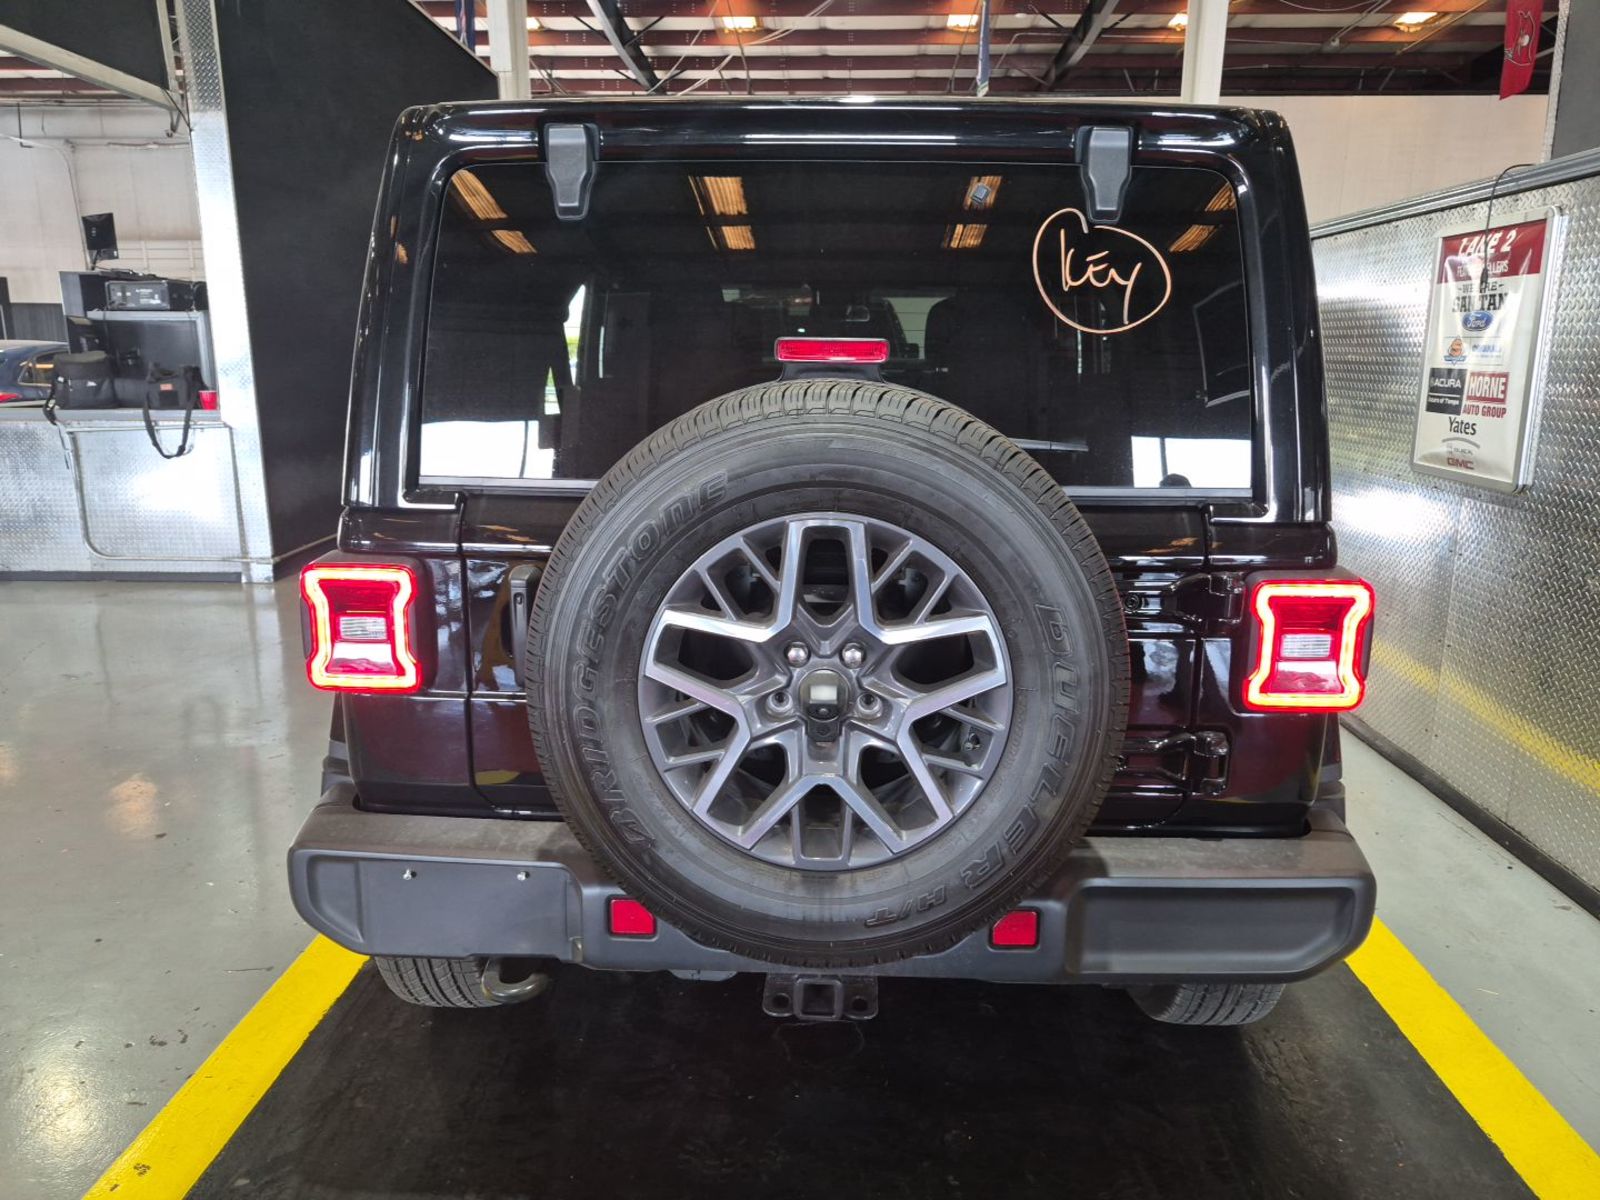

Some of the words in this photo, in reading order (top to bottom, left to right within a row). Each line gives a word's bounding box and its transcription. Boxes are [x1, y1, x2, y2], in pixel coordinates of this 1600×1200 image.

[1500, 228, 1518, 252] 2
[1466, 313, 1488, 327] Ford
[1434, 378, 1461, 388] ACURA
[1468, 375, 1506, 399] HORNE
[1462, 404, 1479, 416] AUTO
[1481, 405, 1507, 418] GROUP
[1448, 416, 1477, 435] Yates
[1447, 457, 1474, 470] GMC
[572, 471, 728, 850] BRIDGESTONE
[961, 603, 1080, 889] DUELER
